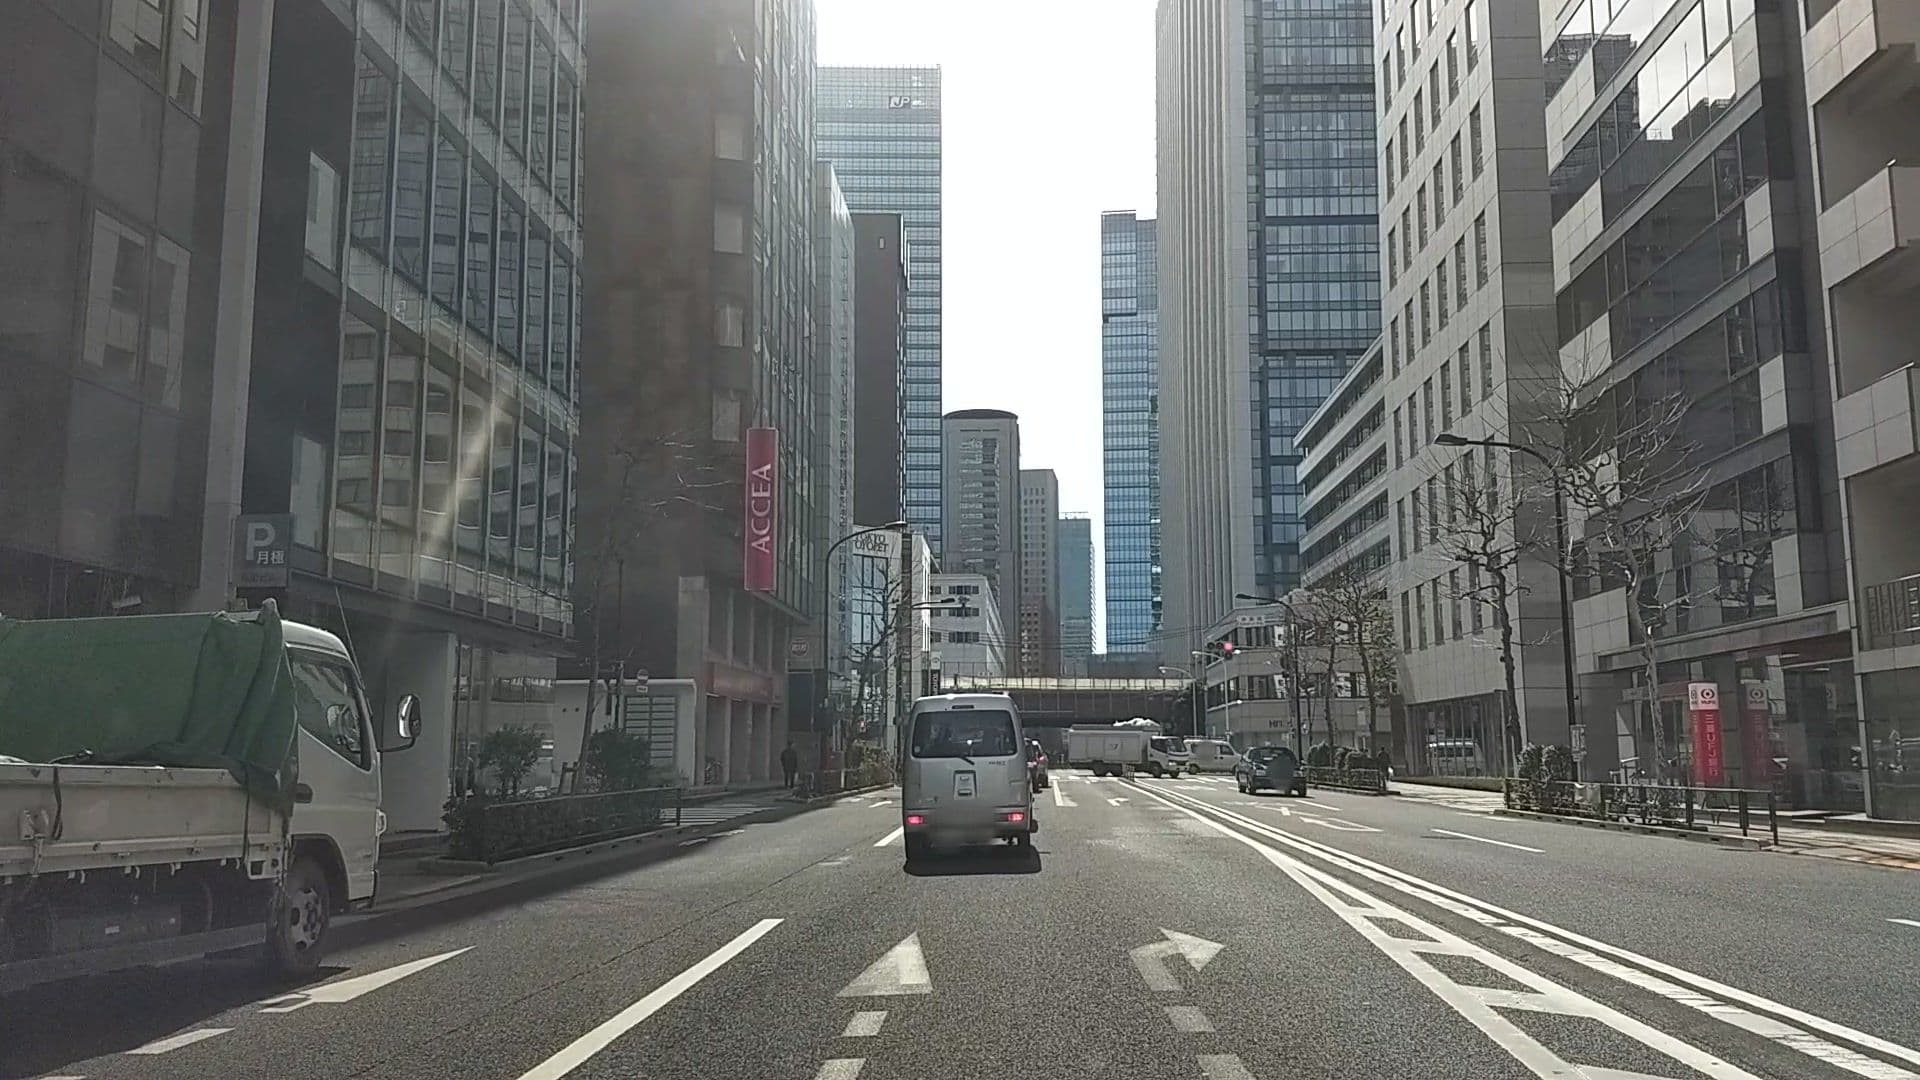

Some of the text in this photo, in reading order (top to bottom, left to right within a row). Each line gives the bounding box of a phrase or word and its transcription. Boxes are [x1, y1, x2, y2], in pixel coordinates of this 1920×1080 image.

[889, 96, 910, 108] JP
[752, 463, 771, 553] ACCEA
[246, 522, 275, 560] P
[853, 540, 888, 552] OYOPET
[256, 550, 285, 565] 月極
